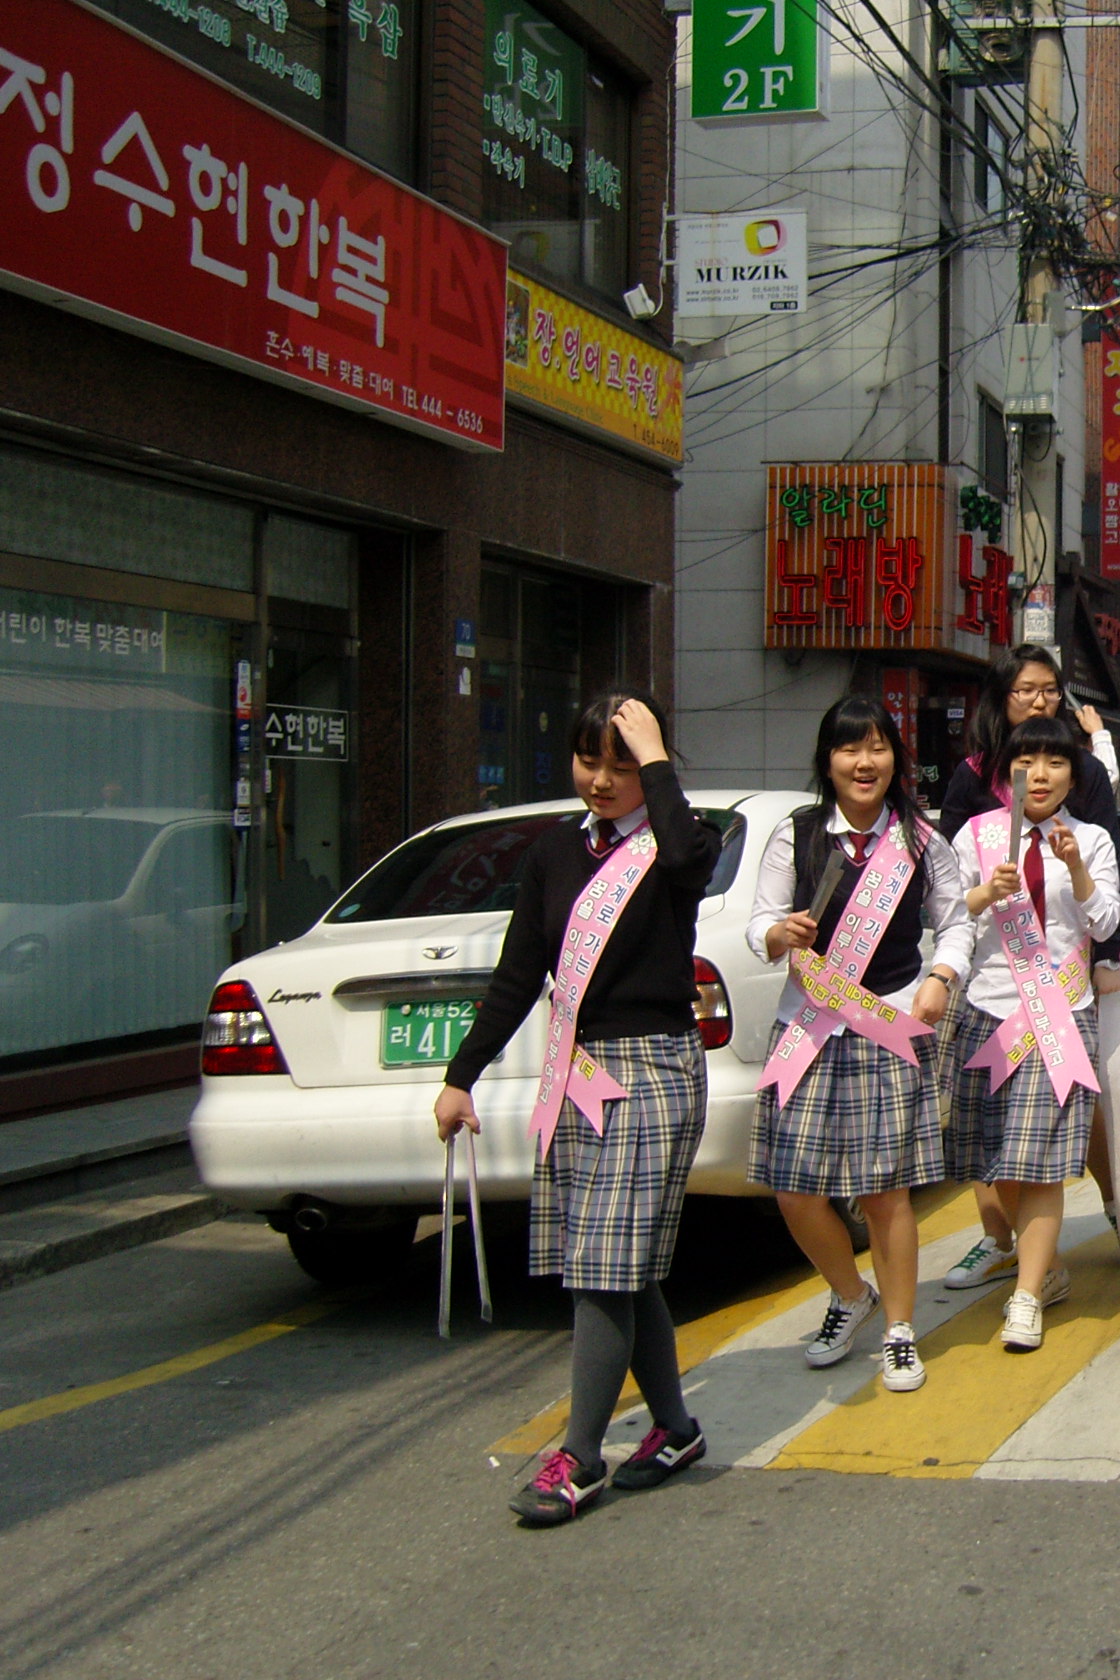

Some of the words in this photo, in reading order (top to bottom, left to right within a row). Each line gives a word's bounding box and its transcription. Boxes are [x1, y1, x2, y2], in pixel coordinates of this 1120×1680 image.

[725, 0, 786, 55] 기
[493, 31, 563, 120] 의료기
[722, 66, 793, 111] 2F
[696, 264, 788, 283] MURZIK
[402, 386, 419, 410] TEL
[607, 351, 658, 416] 교육원
[781, 485, 888, 528] 알라딘
[775, 538, 922, 630] 노래방
[54, 617, 91, 650] 한복
[265, 711, 346, 755] 수현한복
[576, 879, 609, 921] 꿈을
[596, 866, 641, 925] 세계로
[855, 870, 883, 908] 꿈을
[875, 860, 909, 913] 세계로
[574, 933, 603, 977] 가는
[829, 914, 861, 968] 이루는
[854, 918, 882, 958] 가는
[1003, 920, 1031, 974] 이루는
[1018, 911, 1039, 946] 가는
[1035, 954, 1055, 986] 우리
